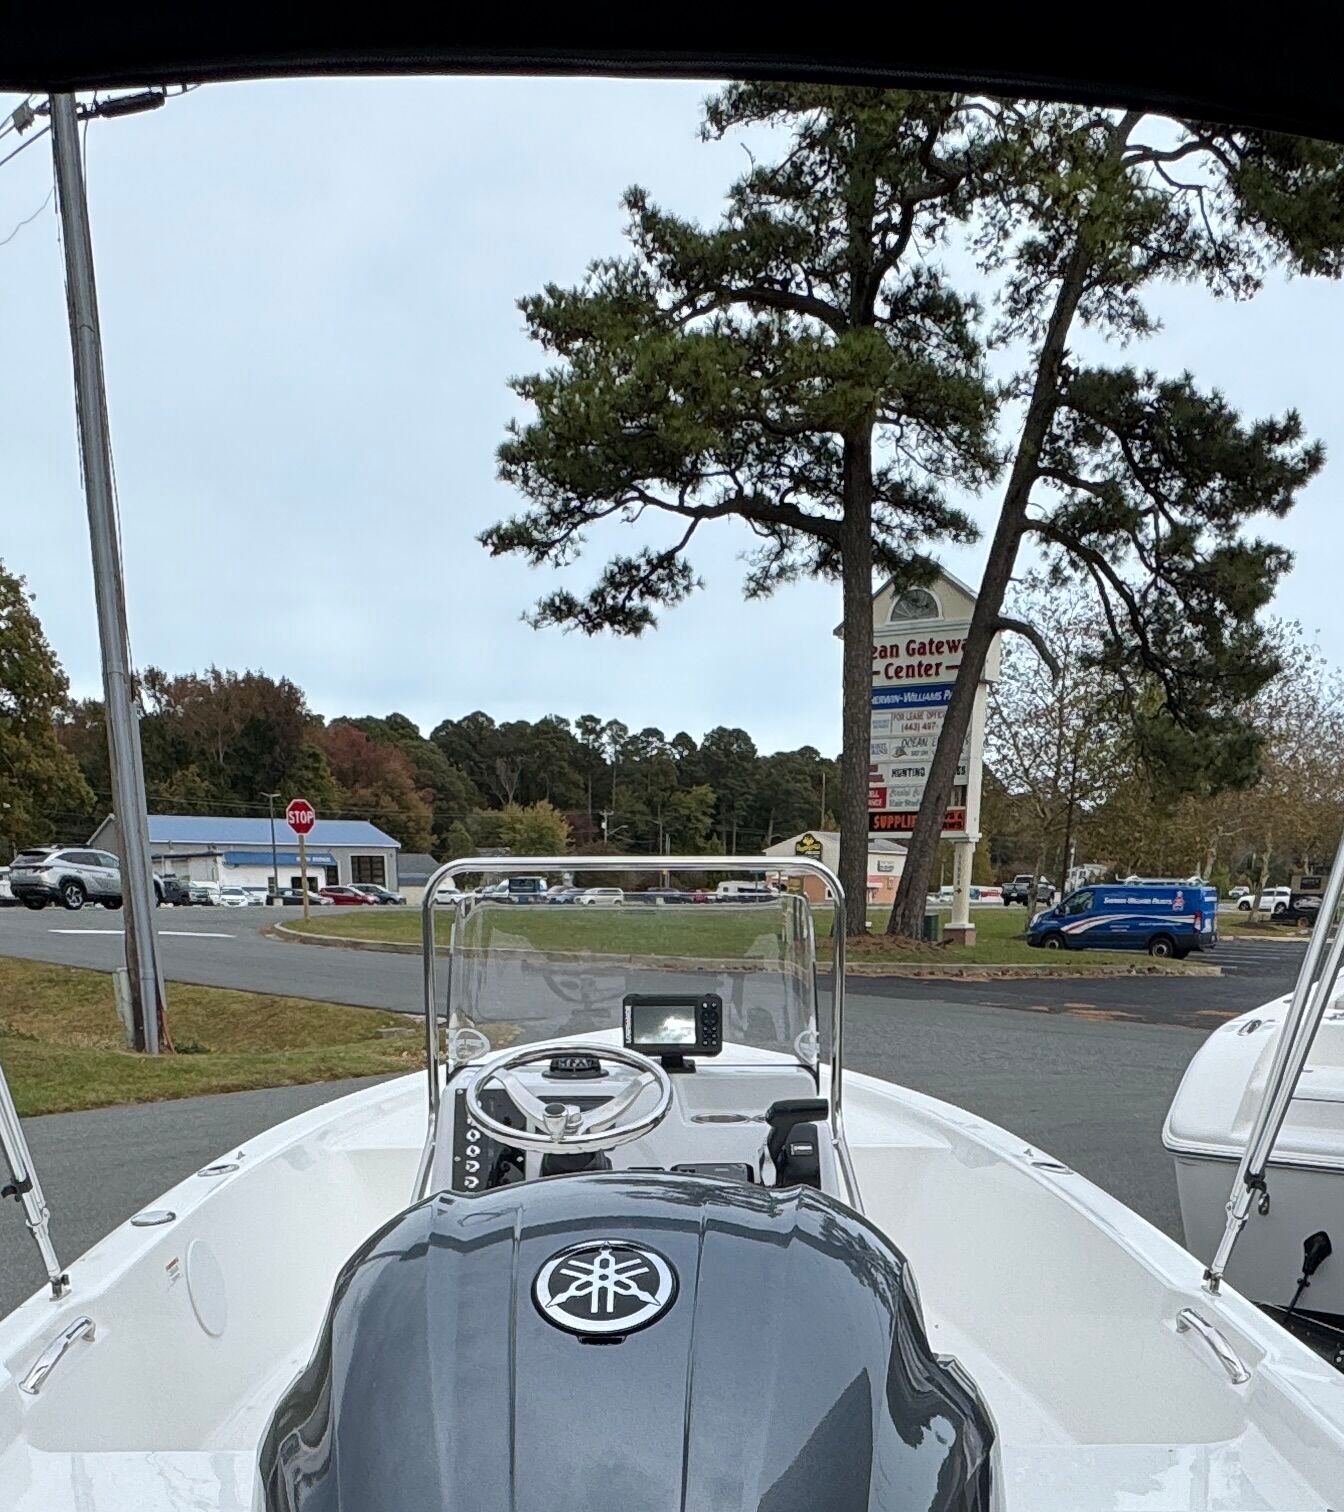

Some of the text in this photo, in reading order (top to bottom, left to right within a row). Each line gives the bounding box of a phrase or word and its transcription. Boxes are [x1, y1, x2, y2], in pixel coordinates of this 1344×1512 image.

[871, 643, 899, 660] ean
[884, 660, 943, 680] Center
[871, 691, 943, 705] ERWIN-WILLIAMS
[288, 810, 313, 824] STOP
